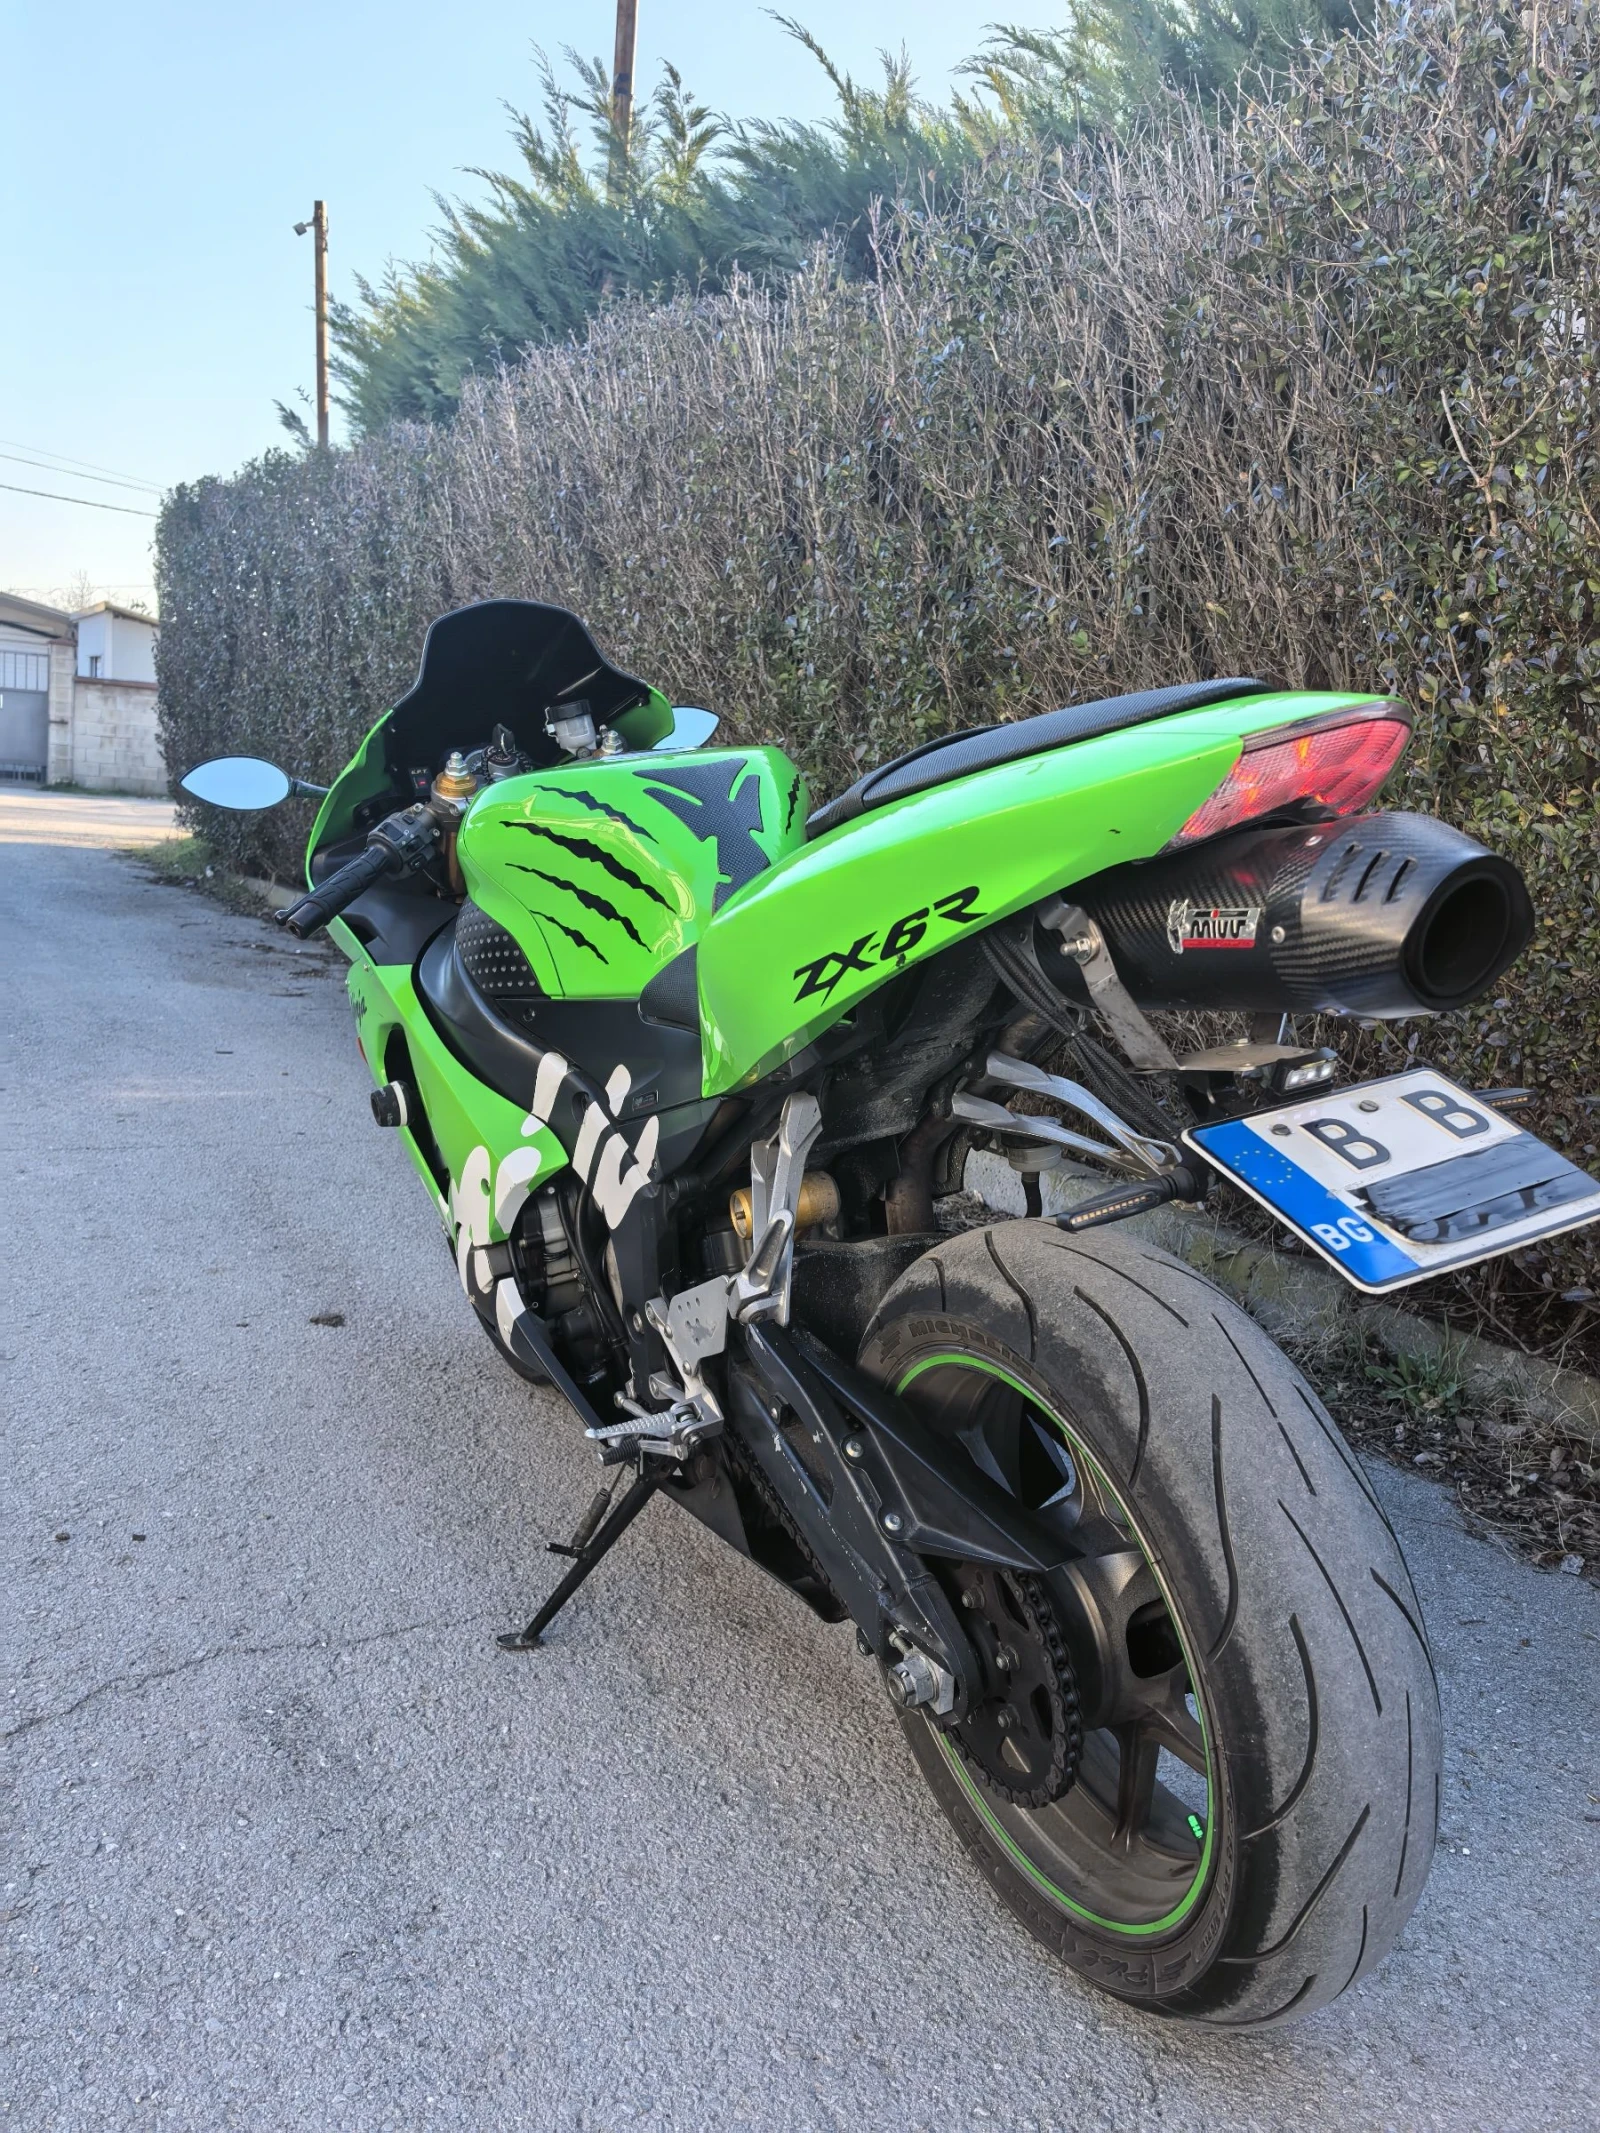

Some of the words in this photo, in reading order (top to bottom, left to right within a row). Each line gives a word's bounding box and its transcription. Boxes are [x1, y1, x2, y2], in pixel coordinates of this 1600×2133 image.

[793, 886, 987, 1006] ZX-6R
[1299, 1118, 1390, 1170] B
[1400, 1090, 1490, 1139] B
[1310, 1216, 1375, 1251] BG
